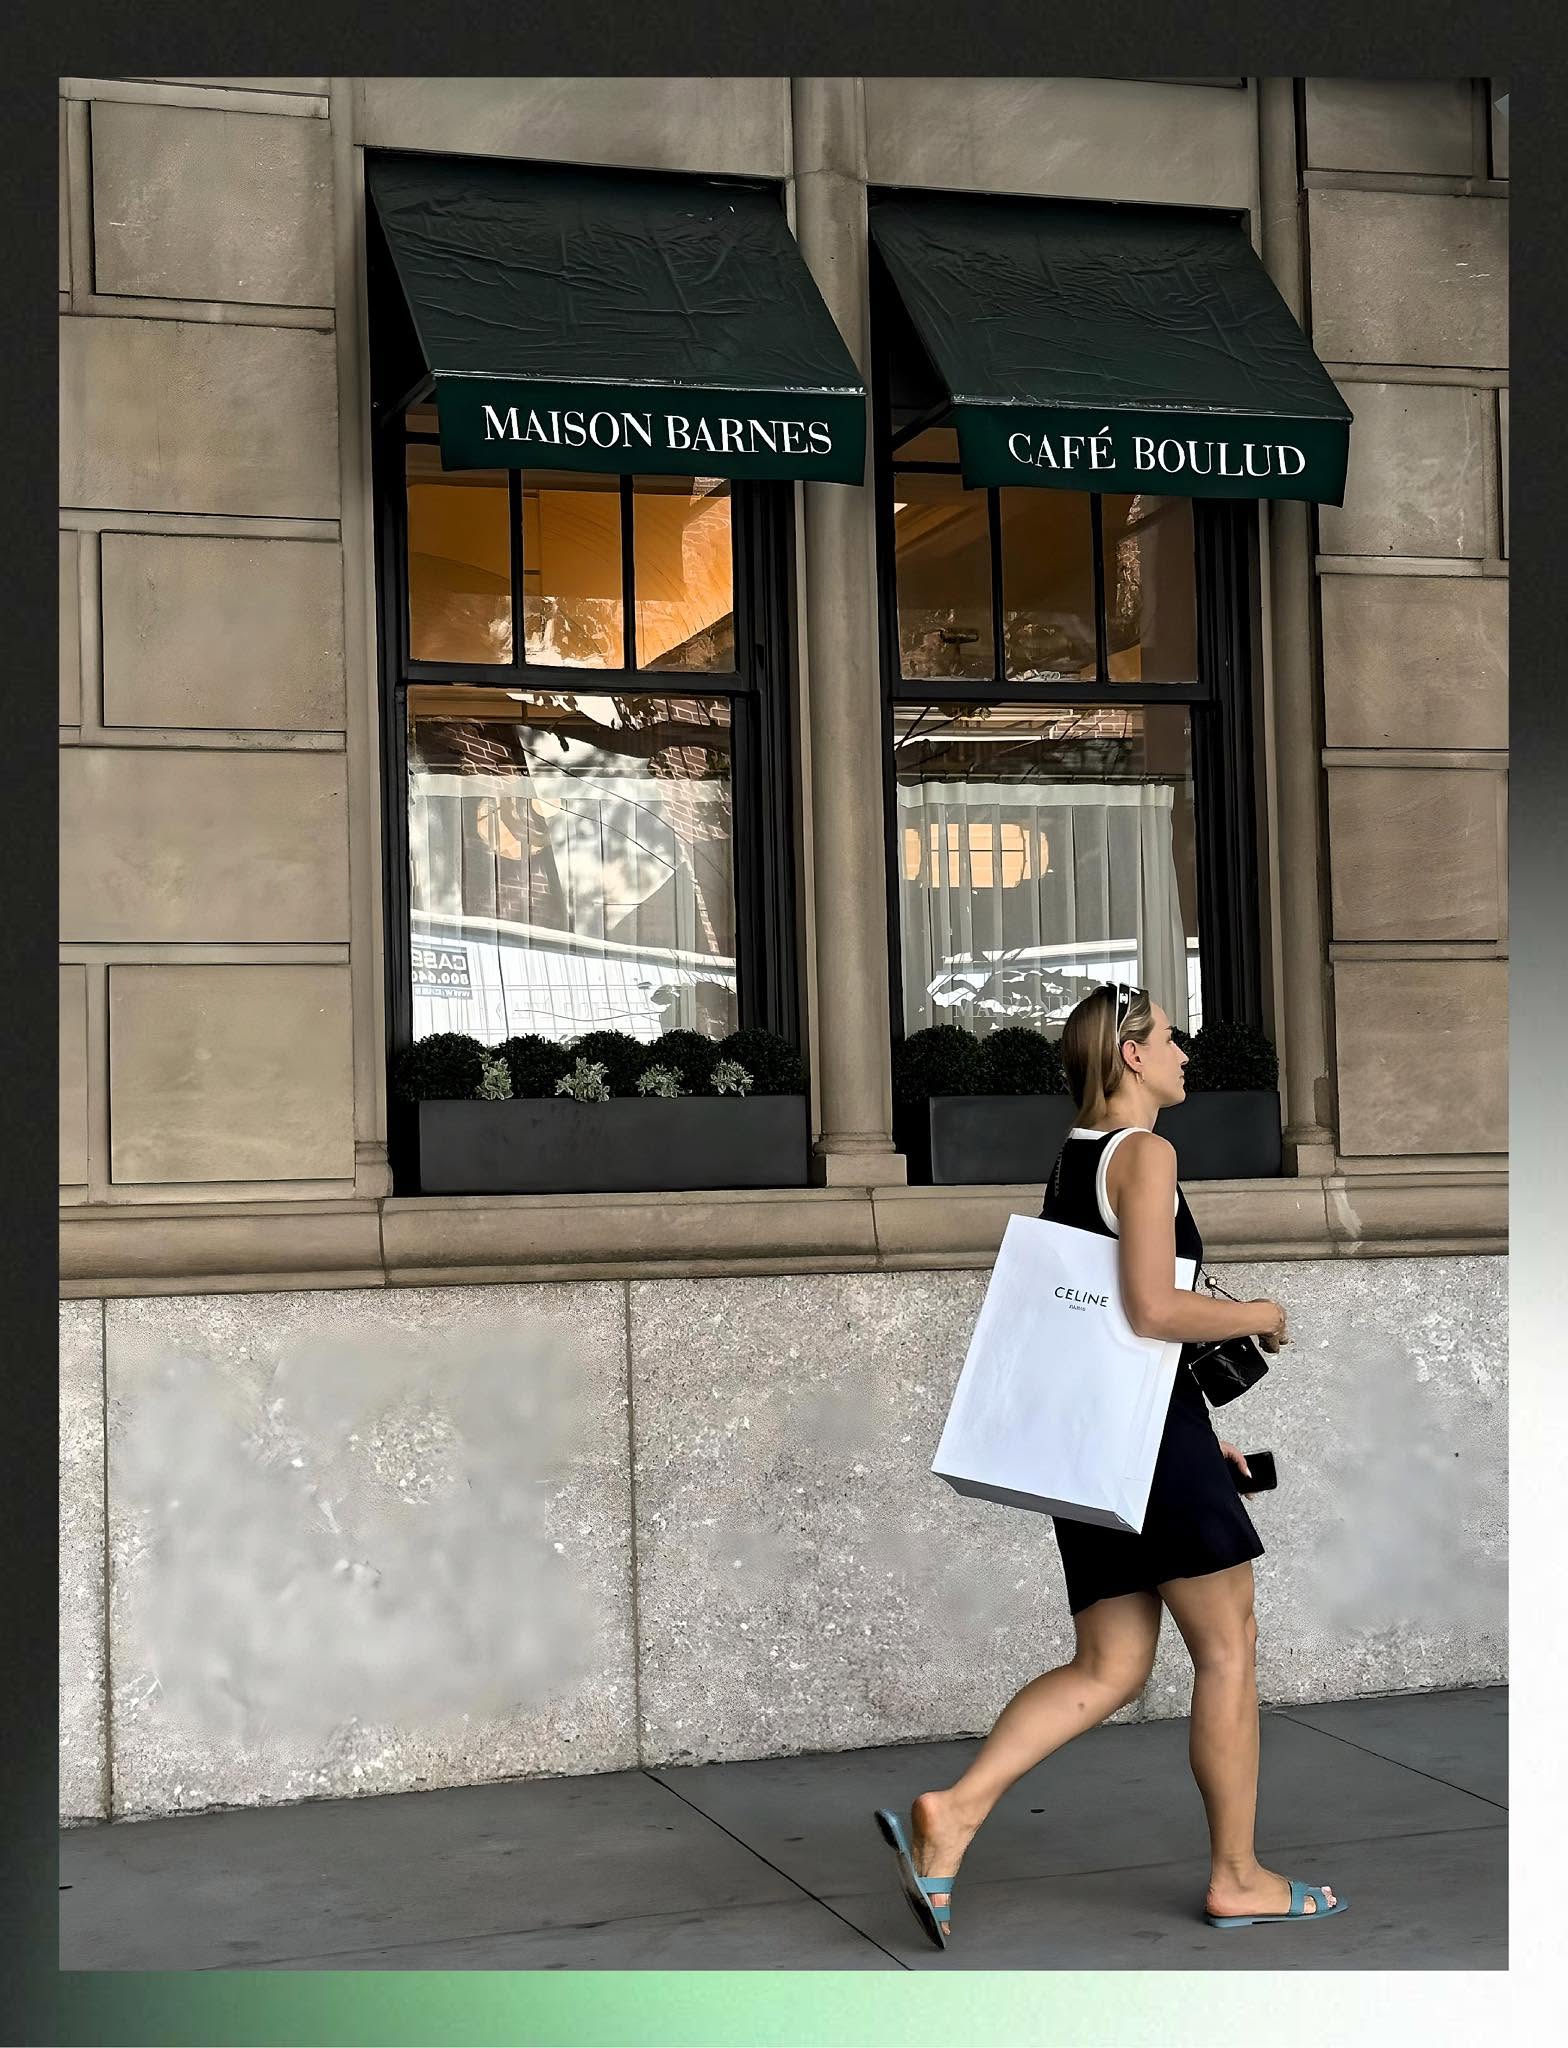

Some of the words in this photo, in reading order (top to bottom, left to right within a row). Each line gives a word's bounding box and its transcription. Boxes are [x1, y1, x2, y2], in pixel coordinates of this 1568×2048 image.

[482, 406, 653, 447] MAISON
[664, 415, 831, 454] BARNES
[1009, 426, 1115, 469] CAFÉ
[1132, 437, 1305, 476] BOULUD
[1055, 1287, 1109, 1307] CELINE
